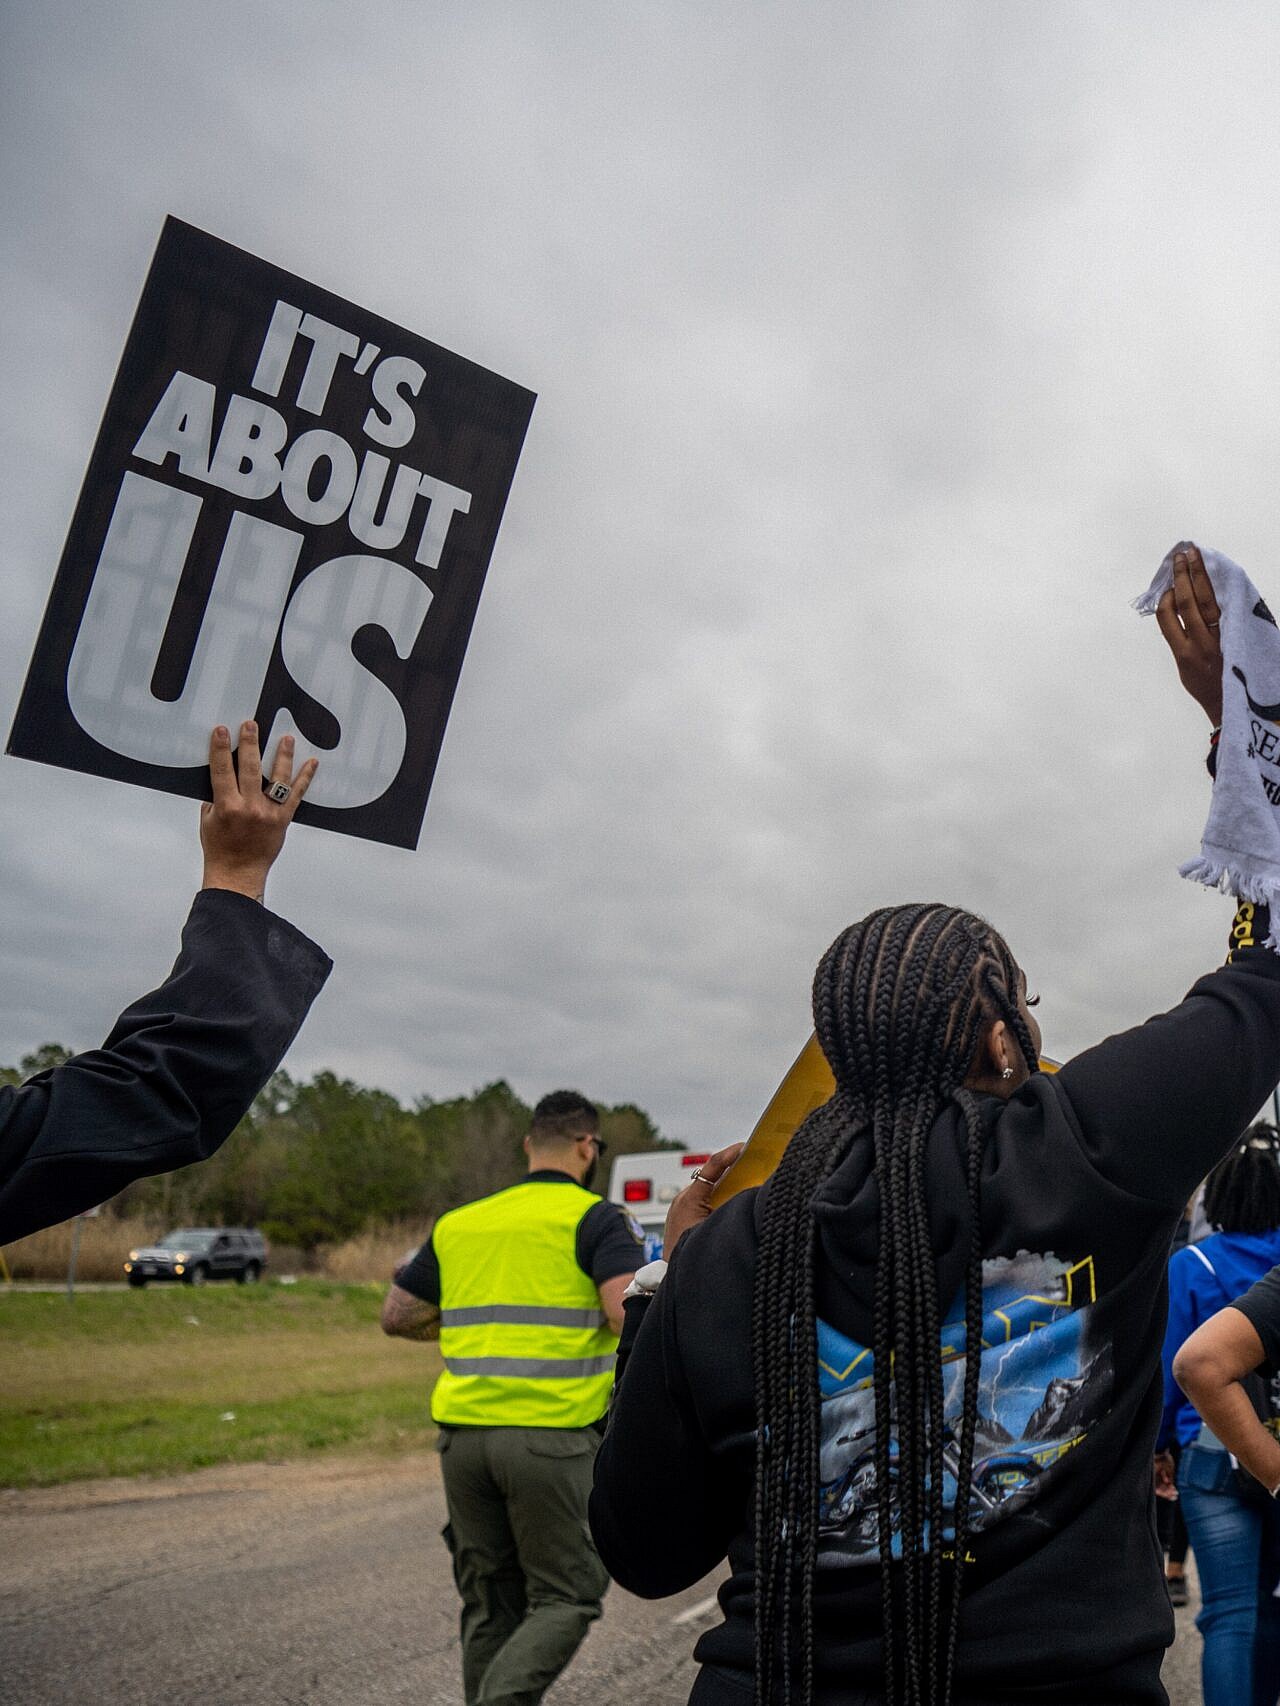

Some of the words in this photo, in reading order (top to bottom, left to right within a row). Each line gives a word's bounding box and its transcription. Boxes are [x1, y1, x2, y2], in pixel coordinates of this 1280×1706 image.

[131, 370, 473, 570] ABOUT
[251, 299, 428, 448] IT'S
[66, 469, 435, 810] US
